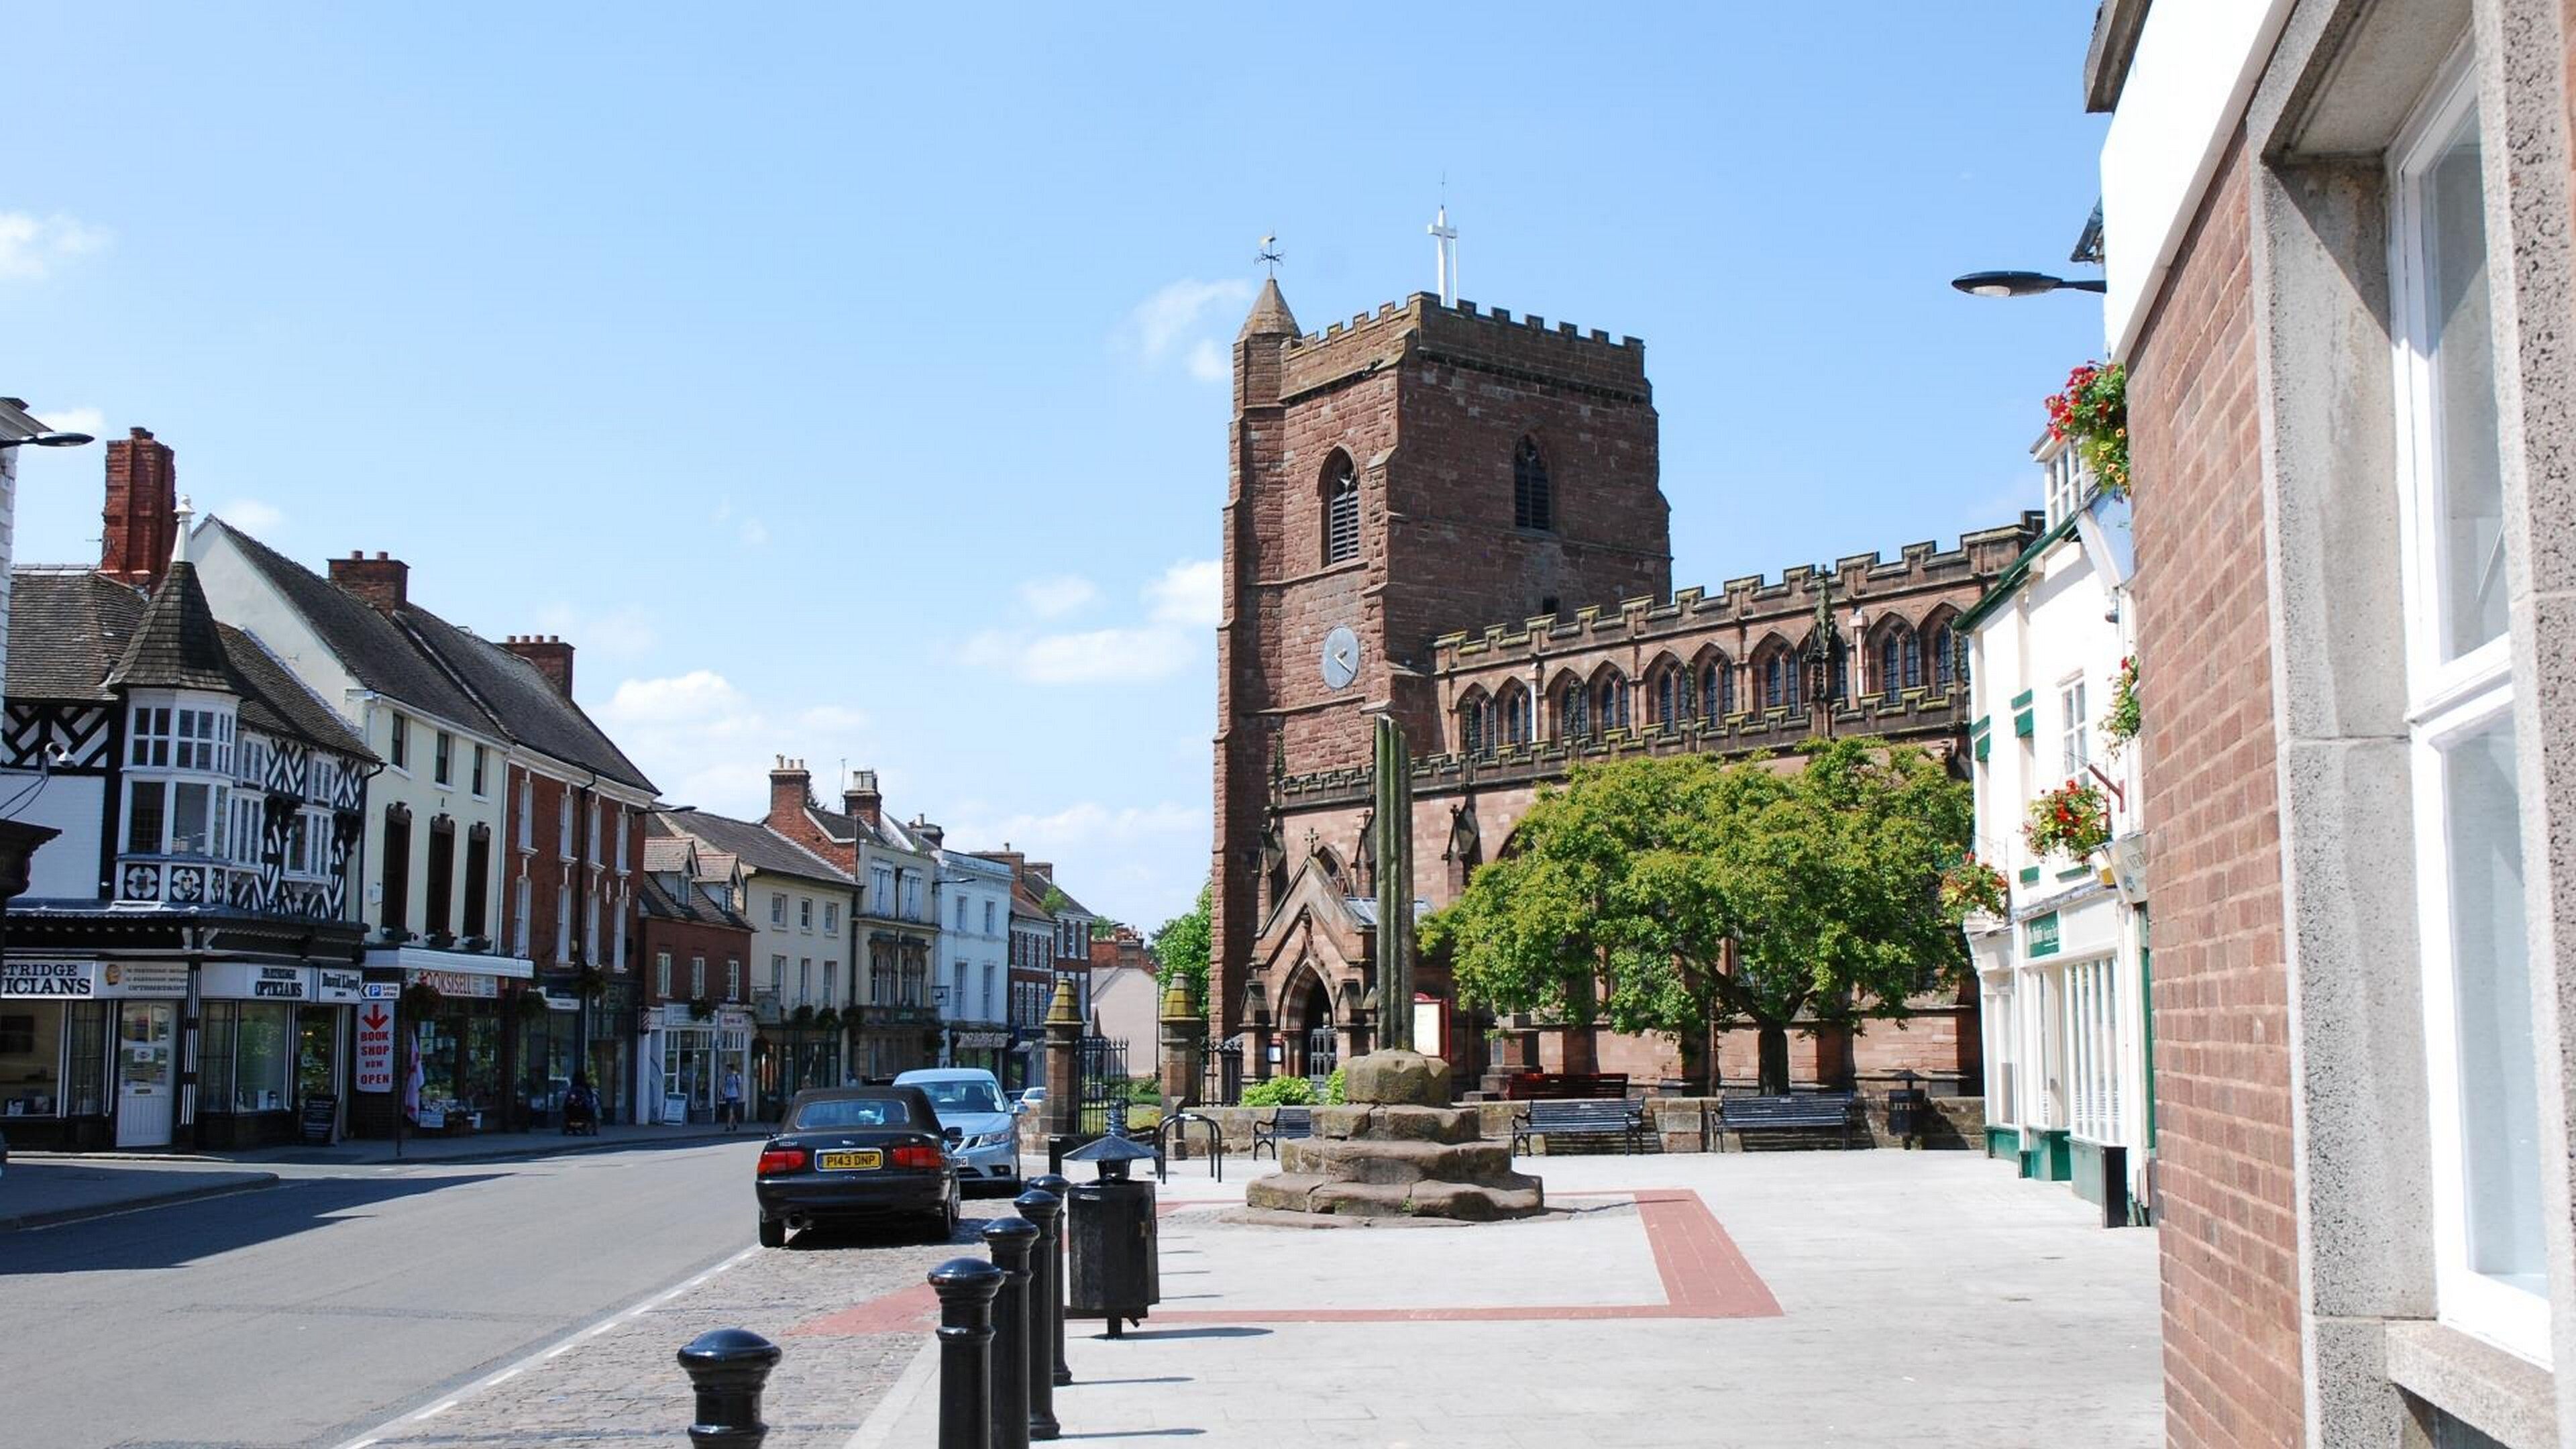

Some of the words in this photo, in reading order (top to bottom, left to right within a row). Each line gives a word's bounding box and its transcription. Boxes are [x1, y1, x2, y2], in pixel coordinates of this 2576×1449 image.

[3, 964, 77, 976] TRIDGE
[4, 978, 91, 994] ICIANS
[256, 981, 303, 998] OPTICIANS
[360, 1031, 389, 1042] BOOK
[361, 1045, 390, 1057] SHOP
[360, 1074, 390, 1085] OPEN
[827, 1156, 851, 1166] P143
[854, 1155, 875, 1165] DNP
